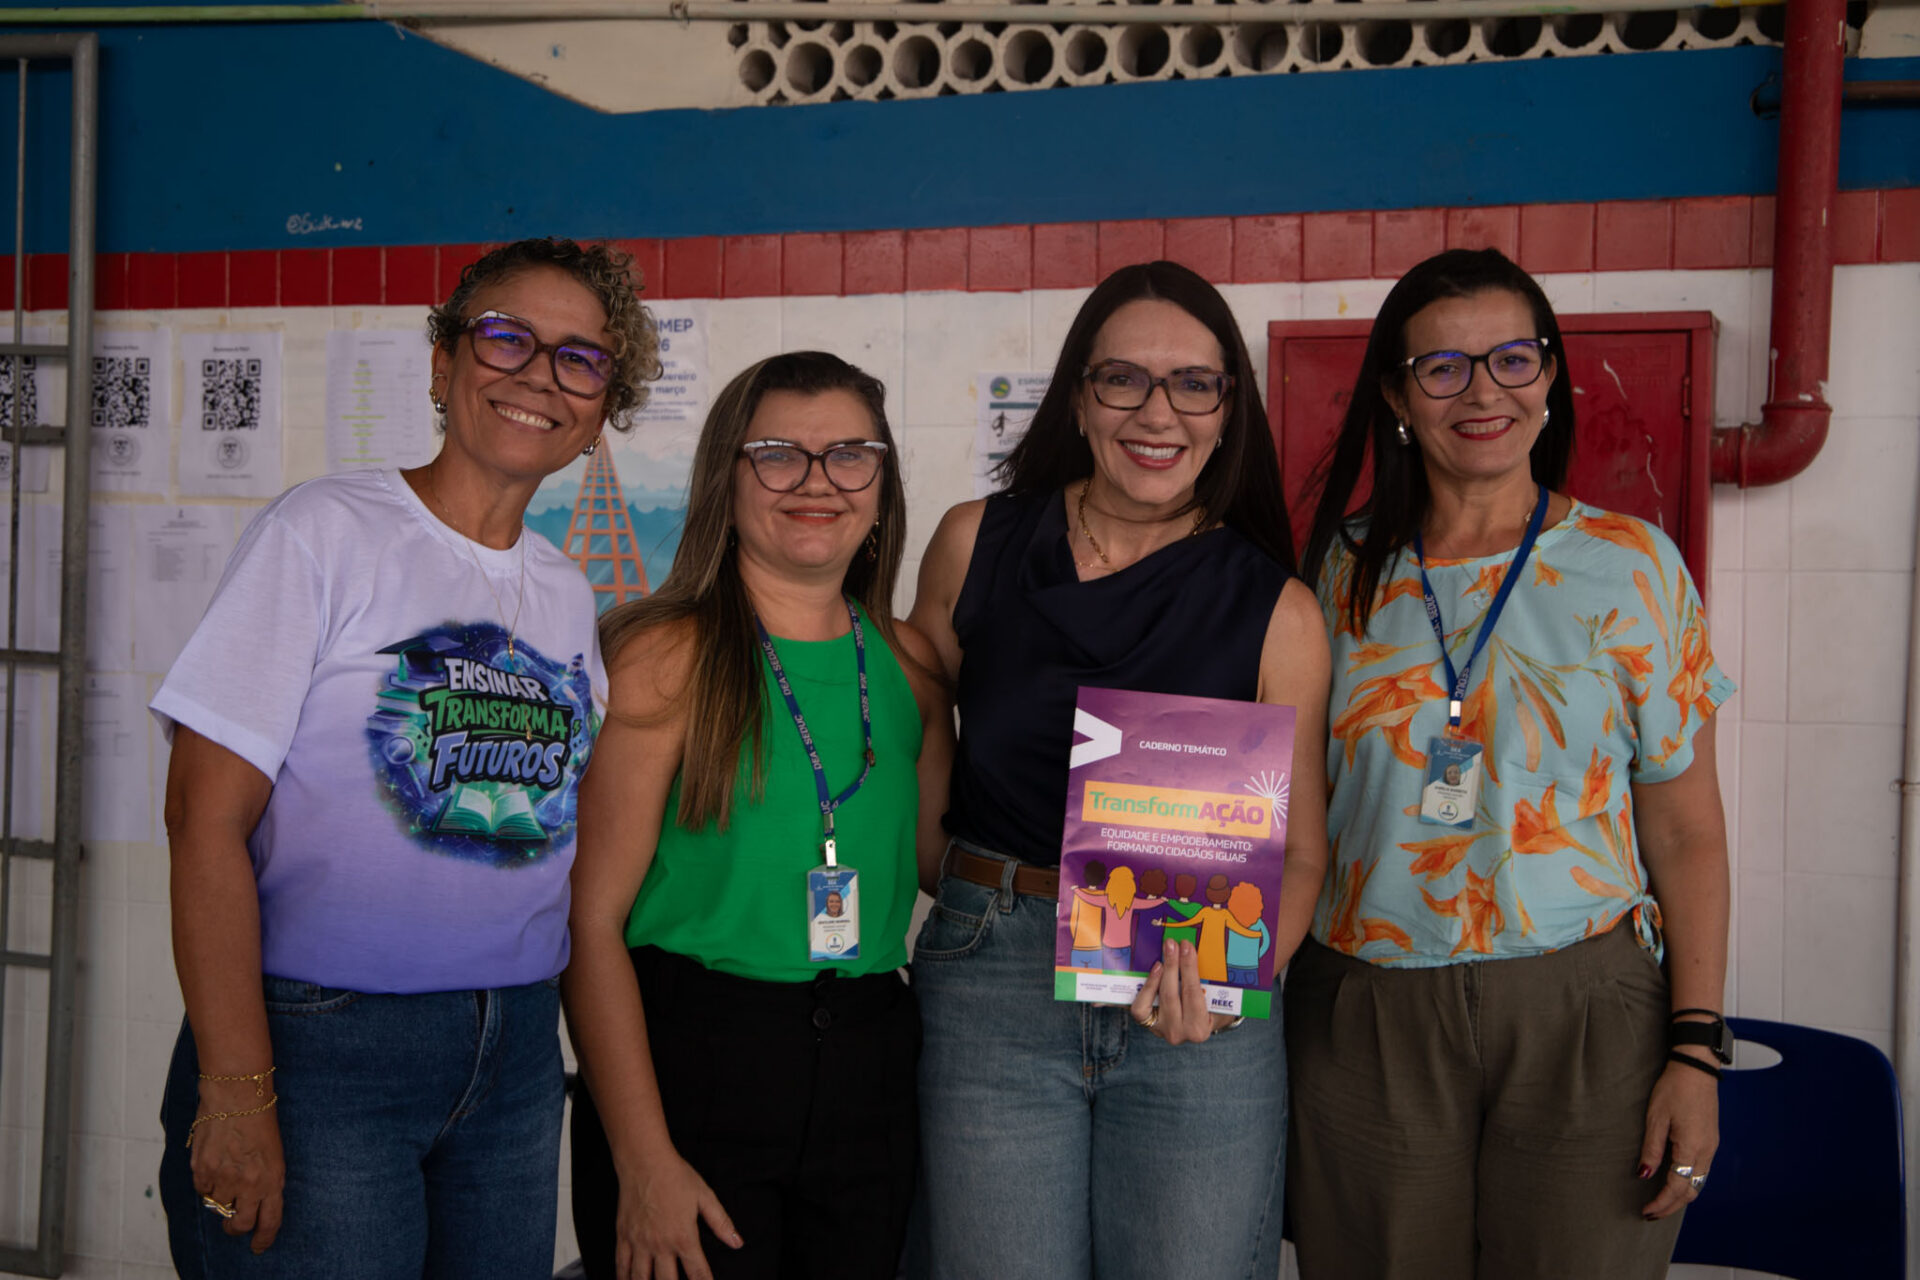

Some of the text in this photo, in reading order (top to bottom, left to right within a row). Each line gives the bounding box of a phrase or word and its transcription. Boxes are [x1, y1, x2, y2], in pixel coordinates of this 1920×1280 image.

[662, 371, 697, 381] vereiro
[762, 640, 782, 673] SEDUC
[444, 658, 548, 701] ENSINAR
[778, 676, 791, 696] DEA
[425, 689, 569, 740] TRANSFORMA
[794, 714, 813, 746] SEDUC
[432, 731, 566, 786] FUTUROS
[1139, 740, 1227, 757] CADERNO TEMÁTICO
[810, 750, 822, 771] DEA
[1089, 791, 1265, 828] TransformAÇÃO
[1101, 827, 1150, 842] EQUIDADE
[1152, 832, 1159, 842] E
[1107, 841, 1247, 863] FORMANDO CIDADÃOS IGUAIS
[1211, 998, 1233, 1008] REEC
